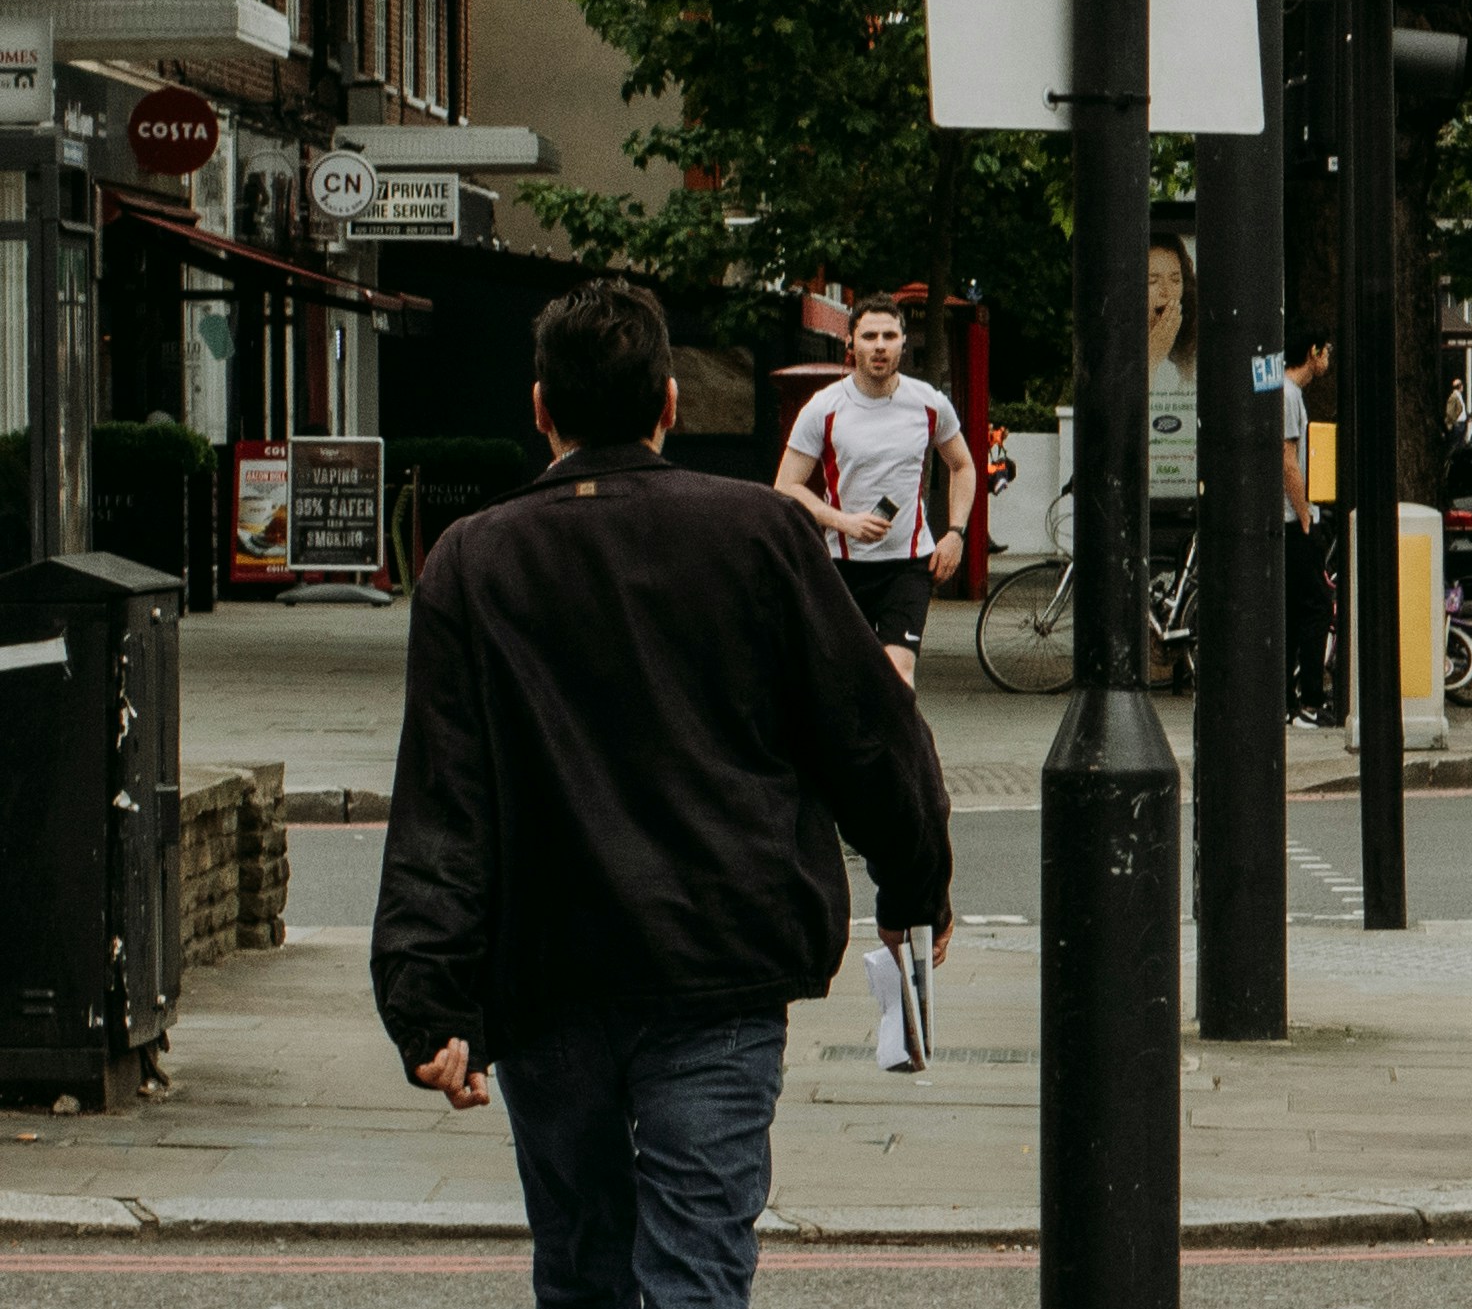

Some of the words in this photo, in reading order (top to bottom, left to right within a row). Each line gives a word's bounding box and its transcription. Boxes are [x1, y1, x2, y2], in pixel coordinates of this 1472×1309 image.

[138, 121, 208, 140] COSTA
[323, 172, 362, 194] CN
[391, 182, 449, 200] PRIVATE
[393, 203, 447, 218] SERVICE
[264, 446, 287, 457] COS
[313, 467, 358, 485] VAPING
[328, 497, 374, 517] SAFER
[306, 530, 363, 548] SMOKING
